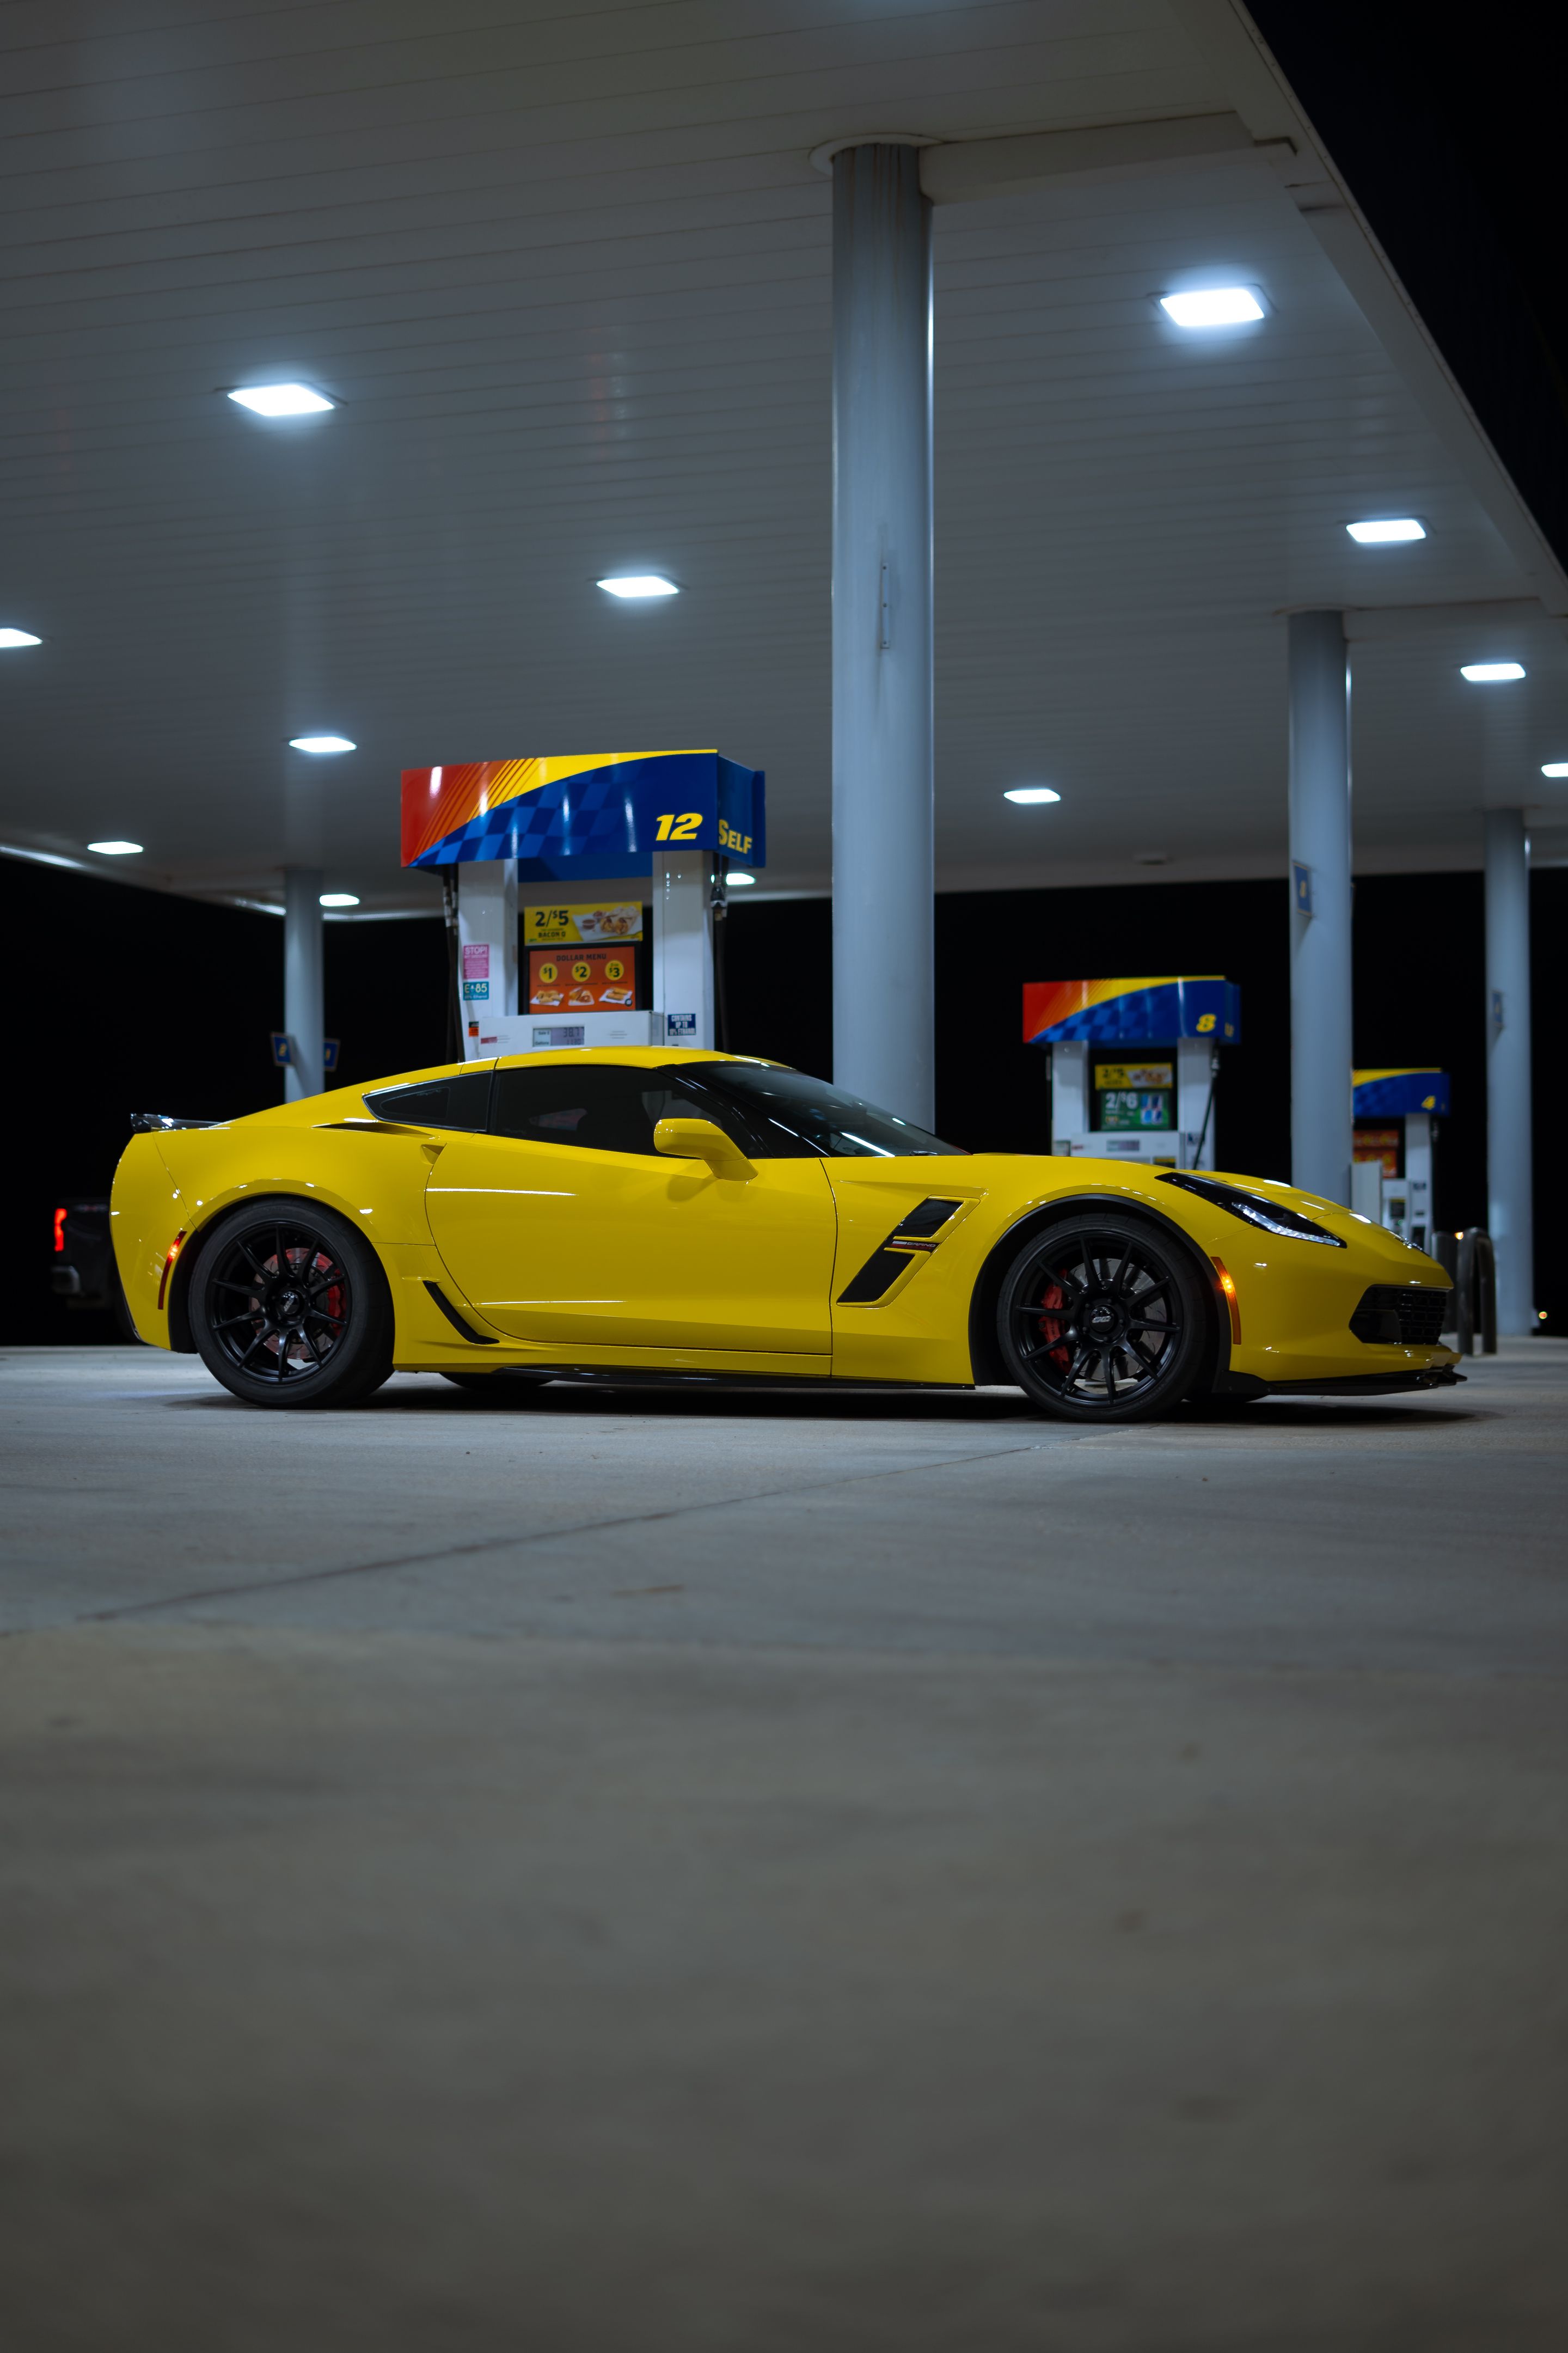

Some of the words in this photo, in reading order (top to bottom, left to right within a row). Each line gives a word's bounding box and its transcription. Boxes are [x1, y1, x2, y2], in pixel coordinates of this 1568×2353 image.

[656, 812, 703, 841] 12
[718, 818, 753, 854] SELF
[535, 909, 569, 928] 2/$5
[543, 967, 553, 979] $1
[575, 966, 587, 978] $2
[609, 967, 620, 977] $3
[1196, 1013, 1216, 1033] 8
[1105, 1091, 1138, 1109] 2/$6
